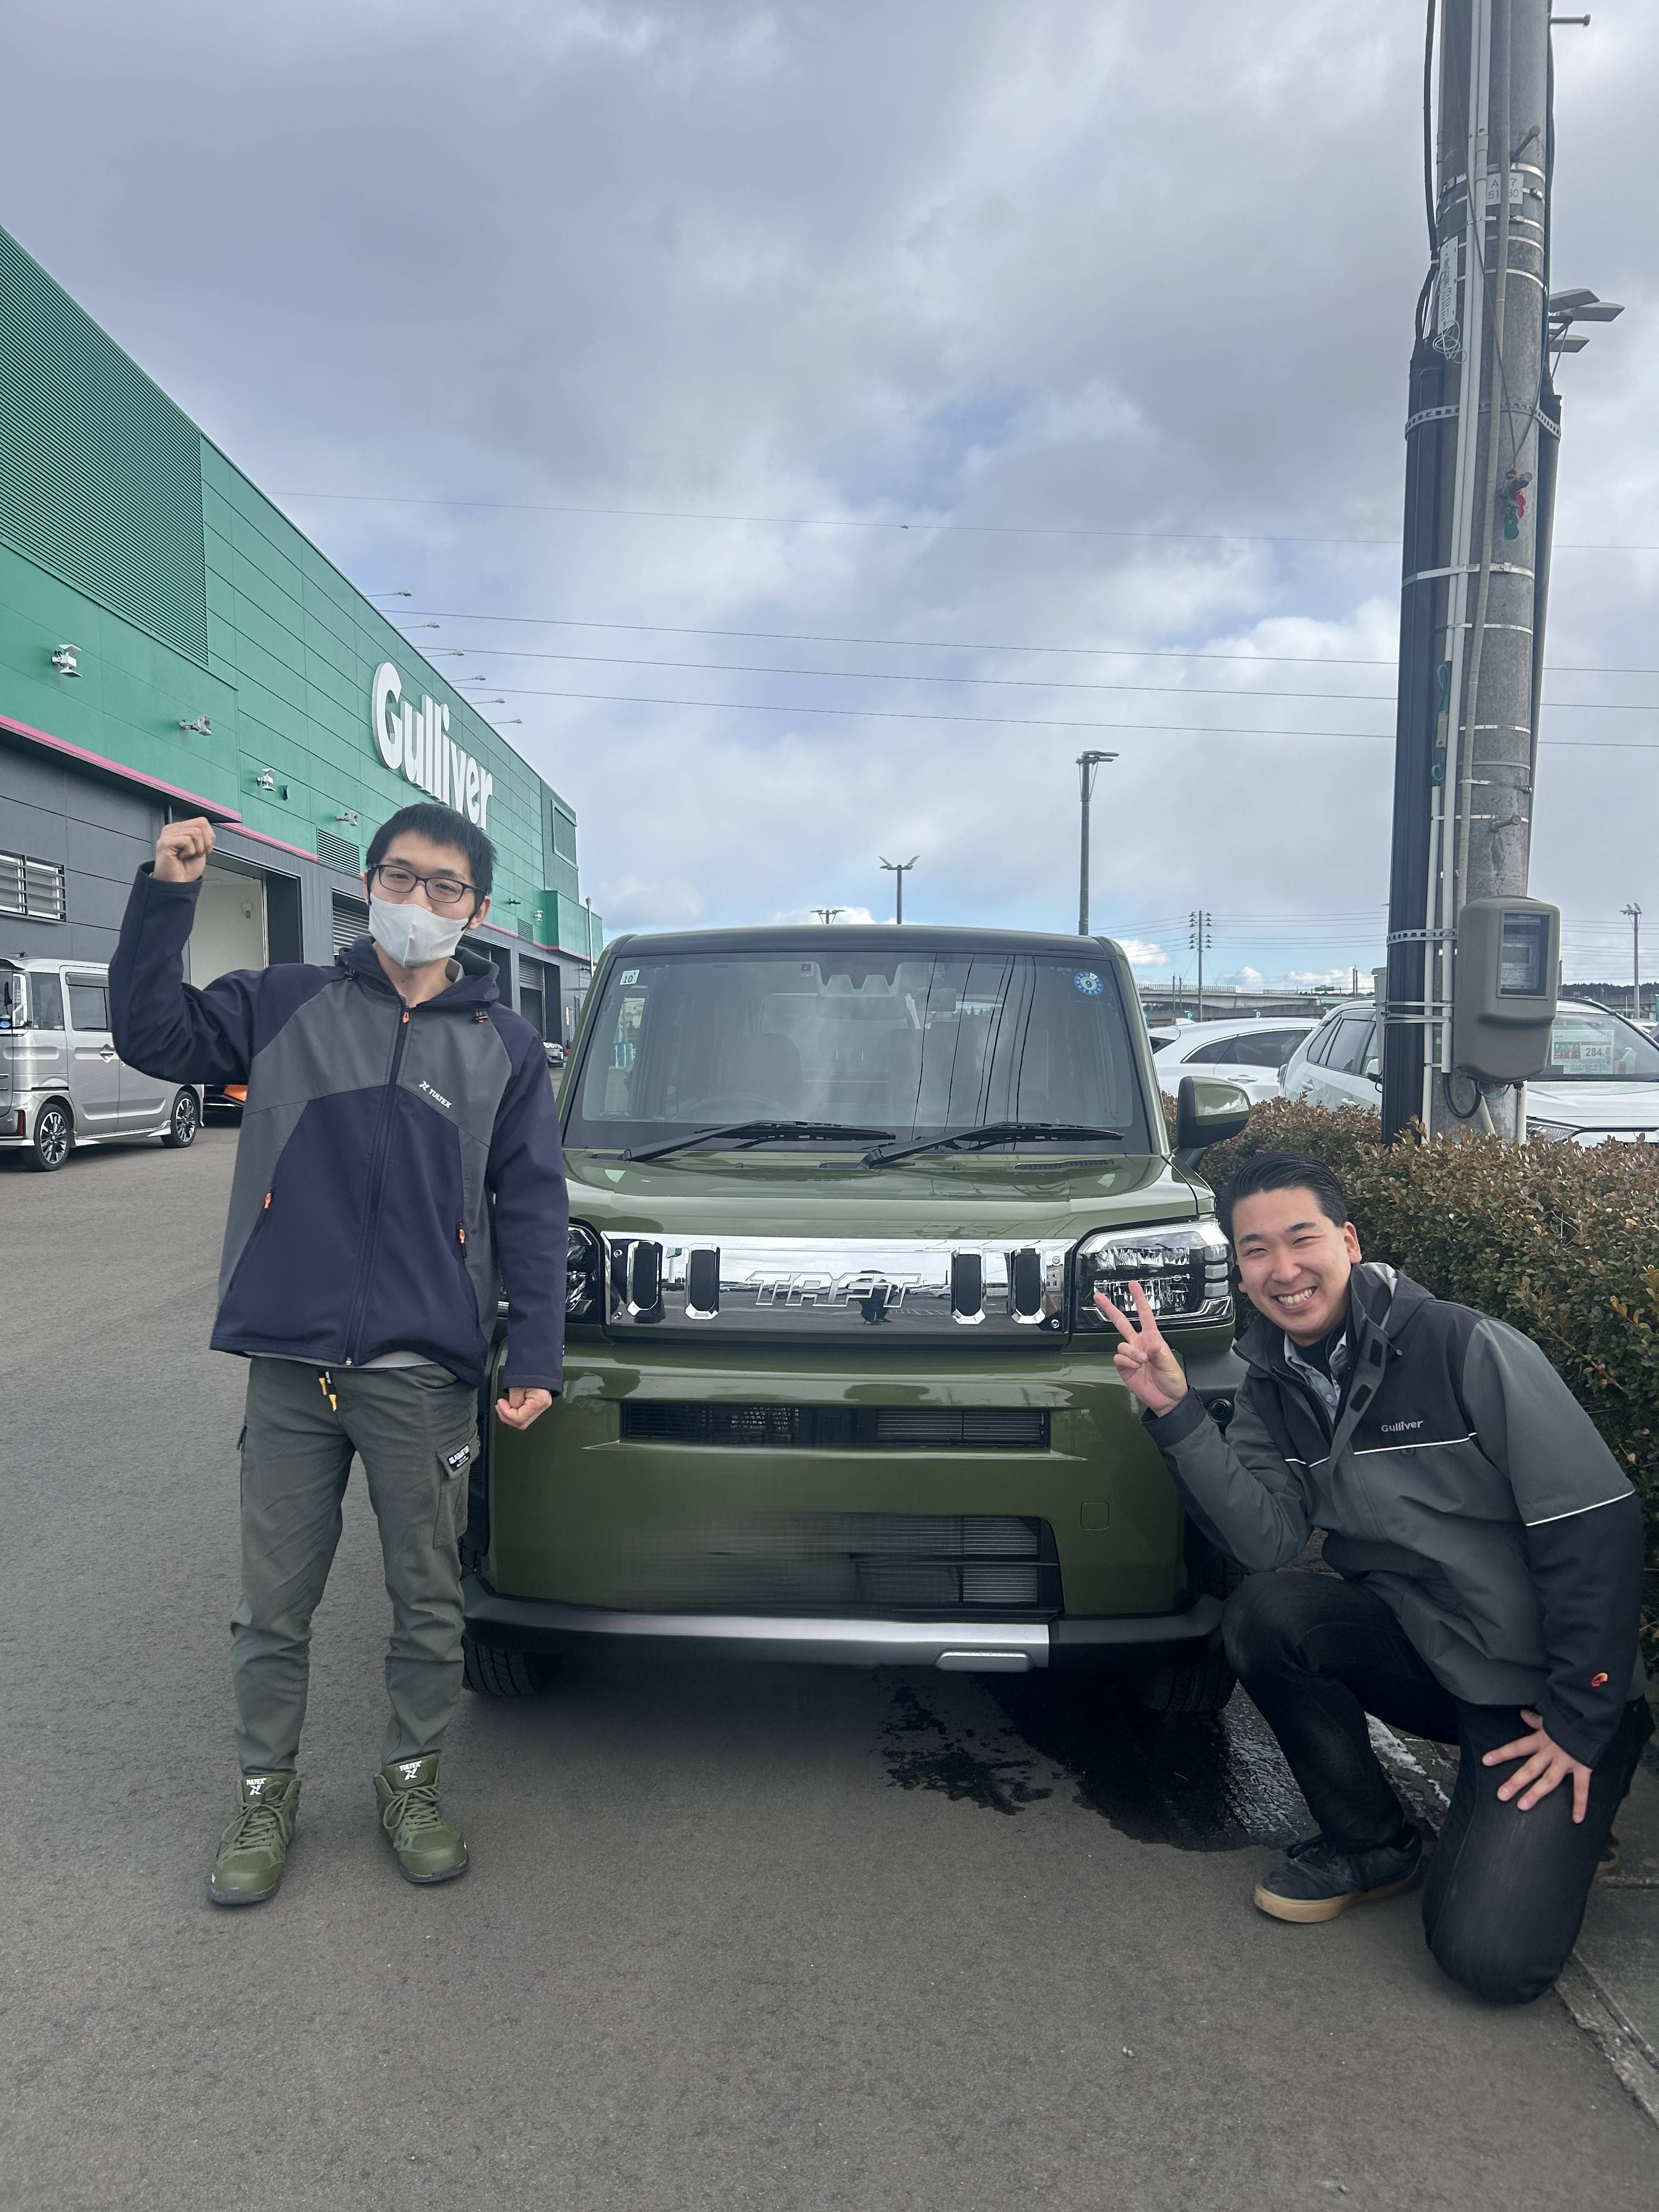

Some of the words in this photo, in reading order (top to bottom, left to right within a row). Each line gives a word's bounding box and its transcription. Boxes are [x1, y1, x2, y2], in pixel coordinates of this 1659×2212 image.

[371, 662, 493, 831] Gulliver
[623, 975, 633, 983] 10
[1086, 980, 1092, 988] 9
[428, 1088, 452, 1108] TULTEX
[744, 1271, 921, 1308] TAFT
[1381, 1420, 1424, 1432] Gulliver
[399, 1760, 422, 1771] TULTEX
